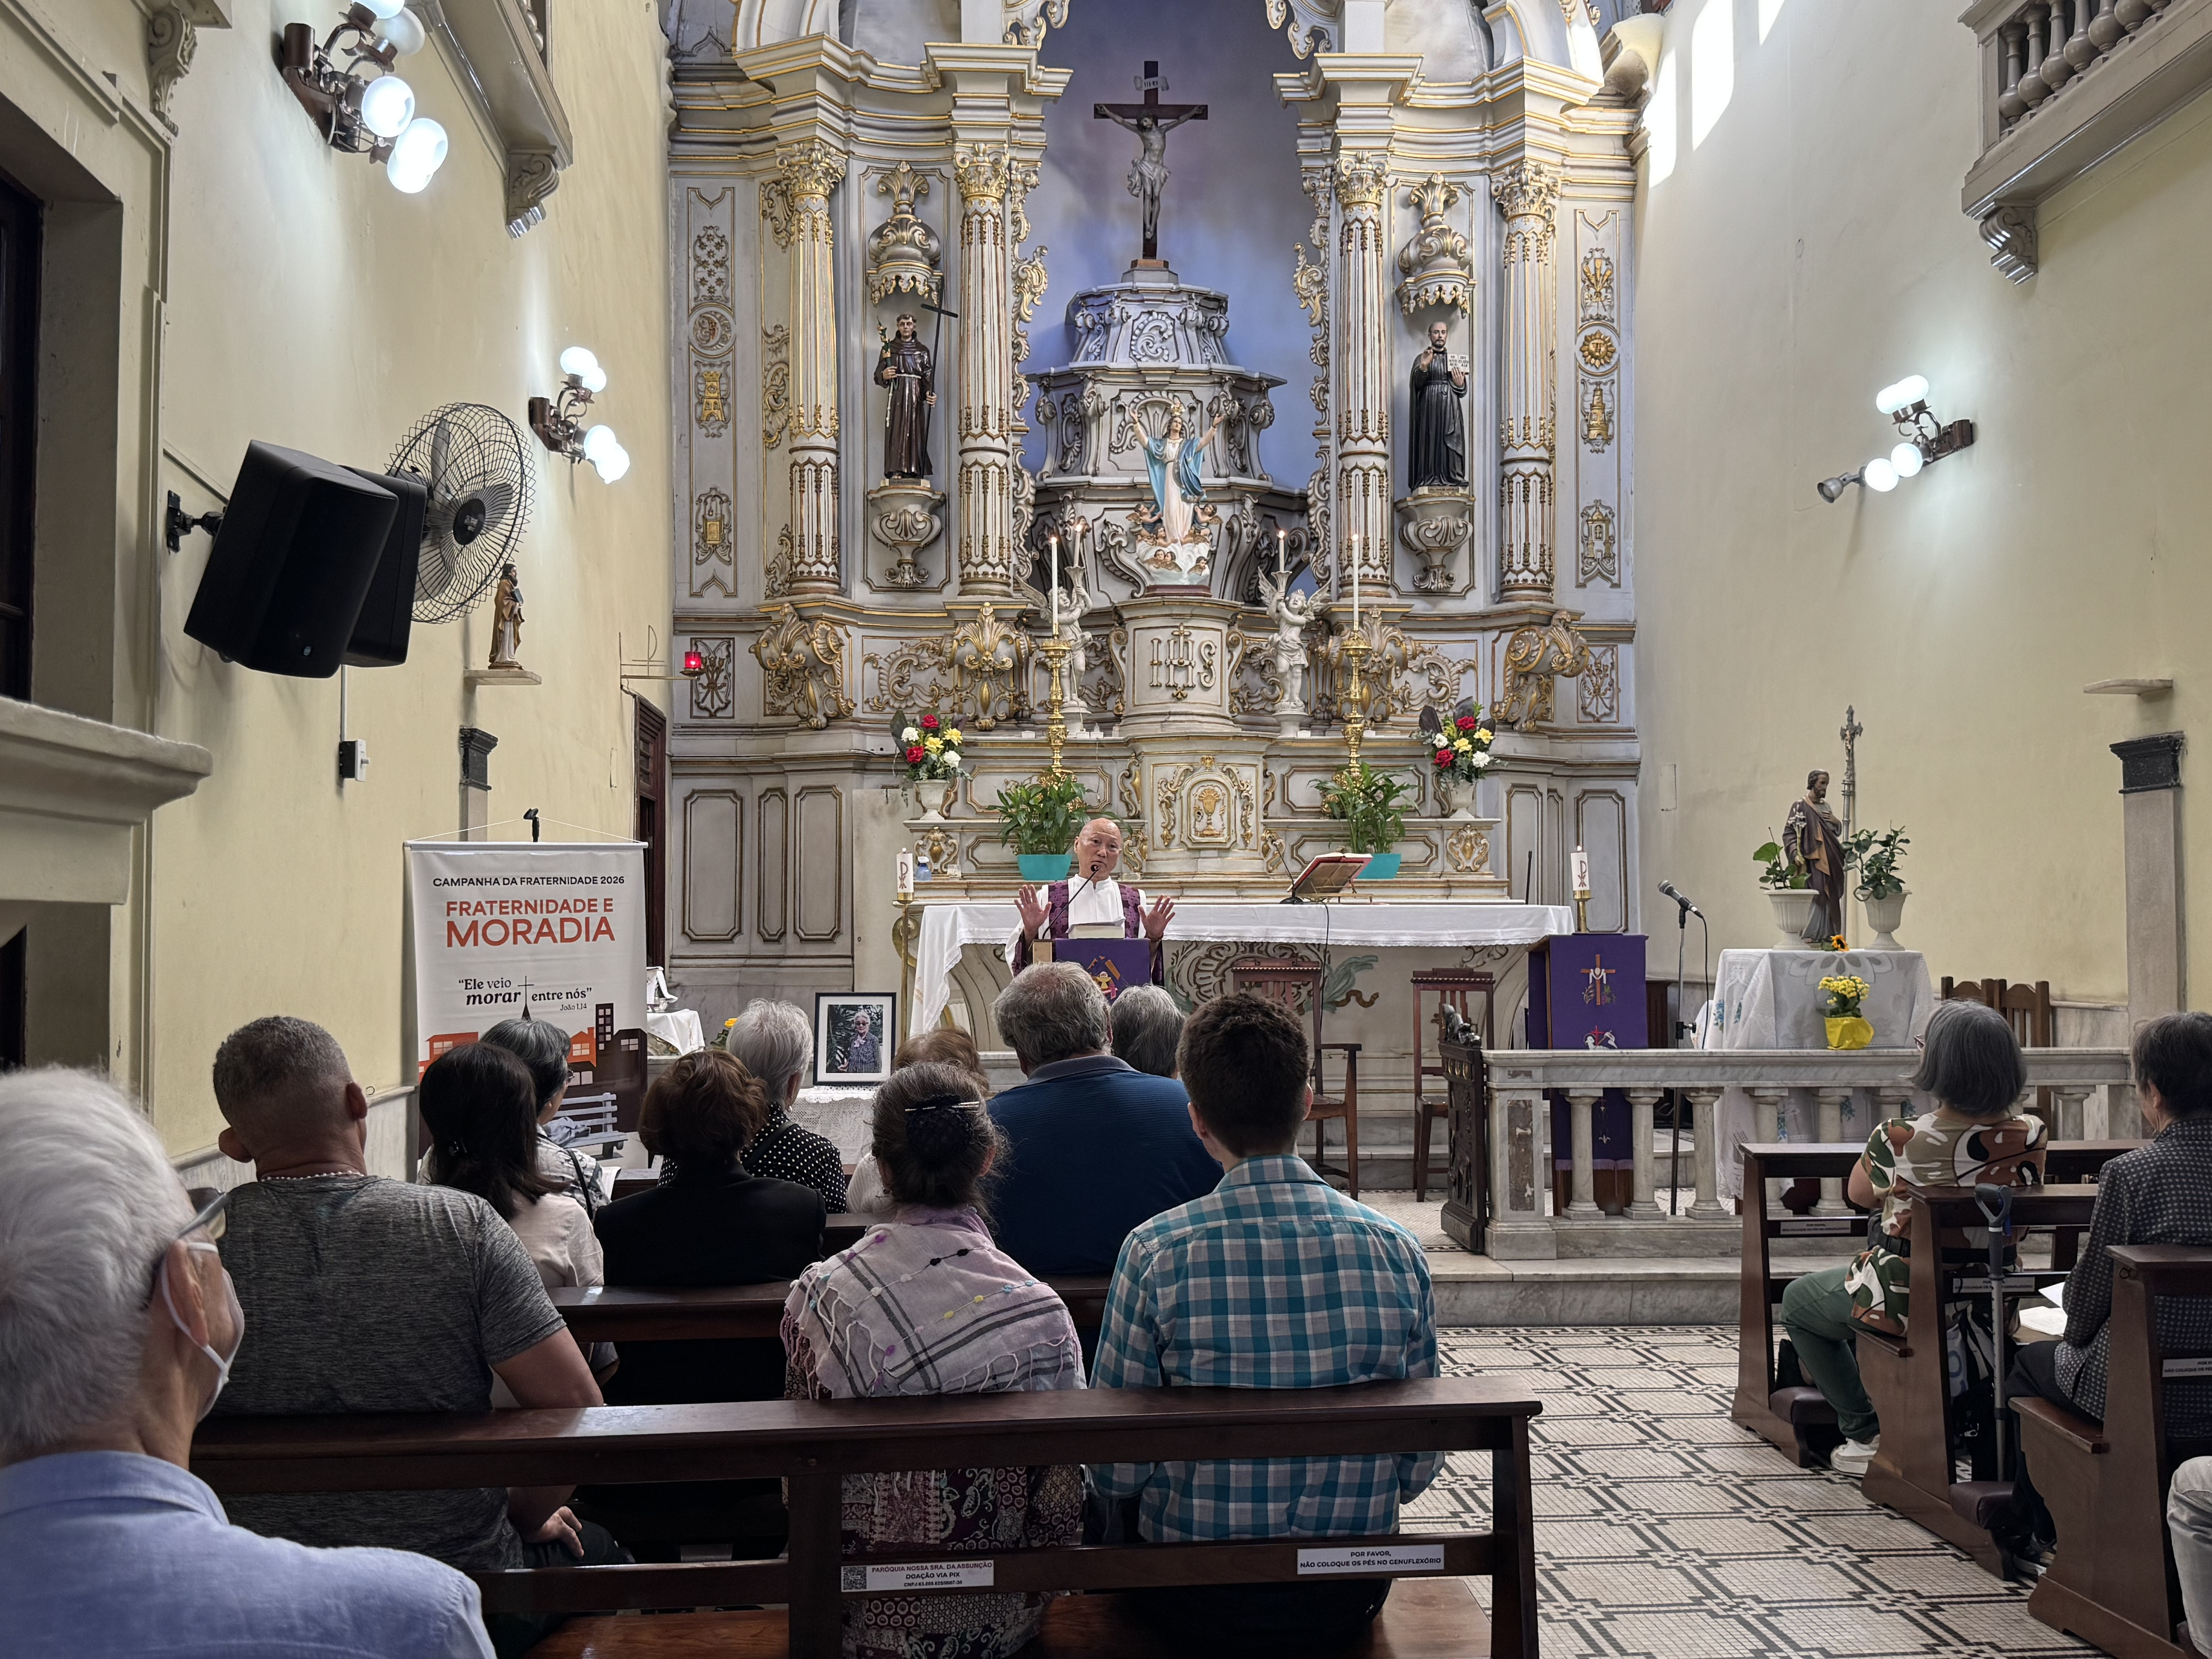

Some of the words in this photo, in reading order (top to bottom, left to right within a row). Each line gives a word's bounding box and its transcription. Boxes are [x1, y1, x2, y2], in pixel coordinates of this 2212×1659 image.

[433, 877, 500, 887] CAMPANHA
[503, 877, 518, 886] DA
[520, 876, 598, 885] FRATERNIDADE
[600, 876, 624, 884] 2026
[446, 898, 598, 916] FRATERNIDADE
[603, 898, 613, 912] E
[447, 916, 616, 948] MORADIA
[459, 979, 484, 990] “Ele
[487, 977, 511, 989] veio
[466, 992, 521, 1005] morar
[531, 991, 563, 1001] entre
[565, 987, 592, 999] nós”
[905, 1572, 935, 1580] DOAÇÃO
